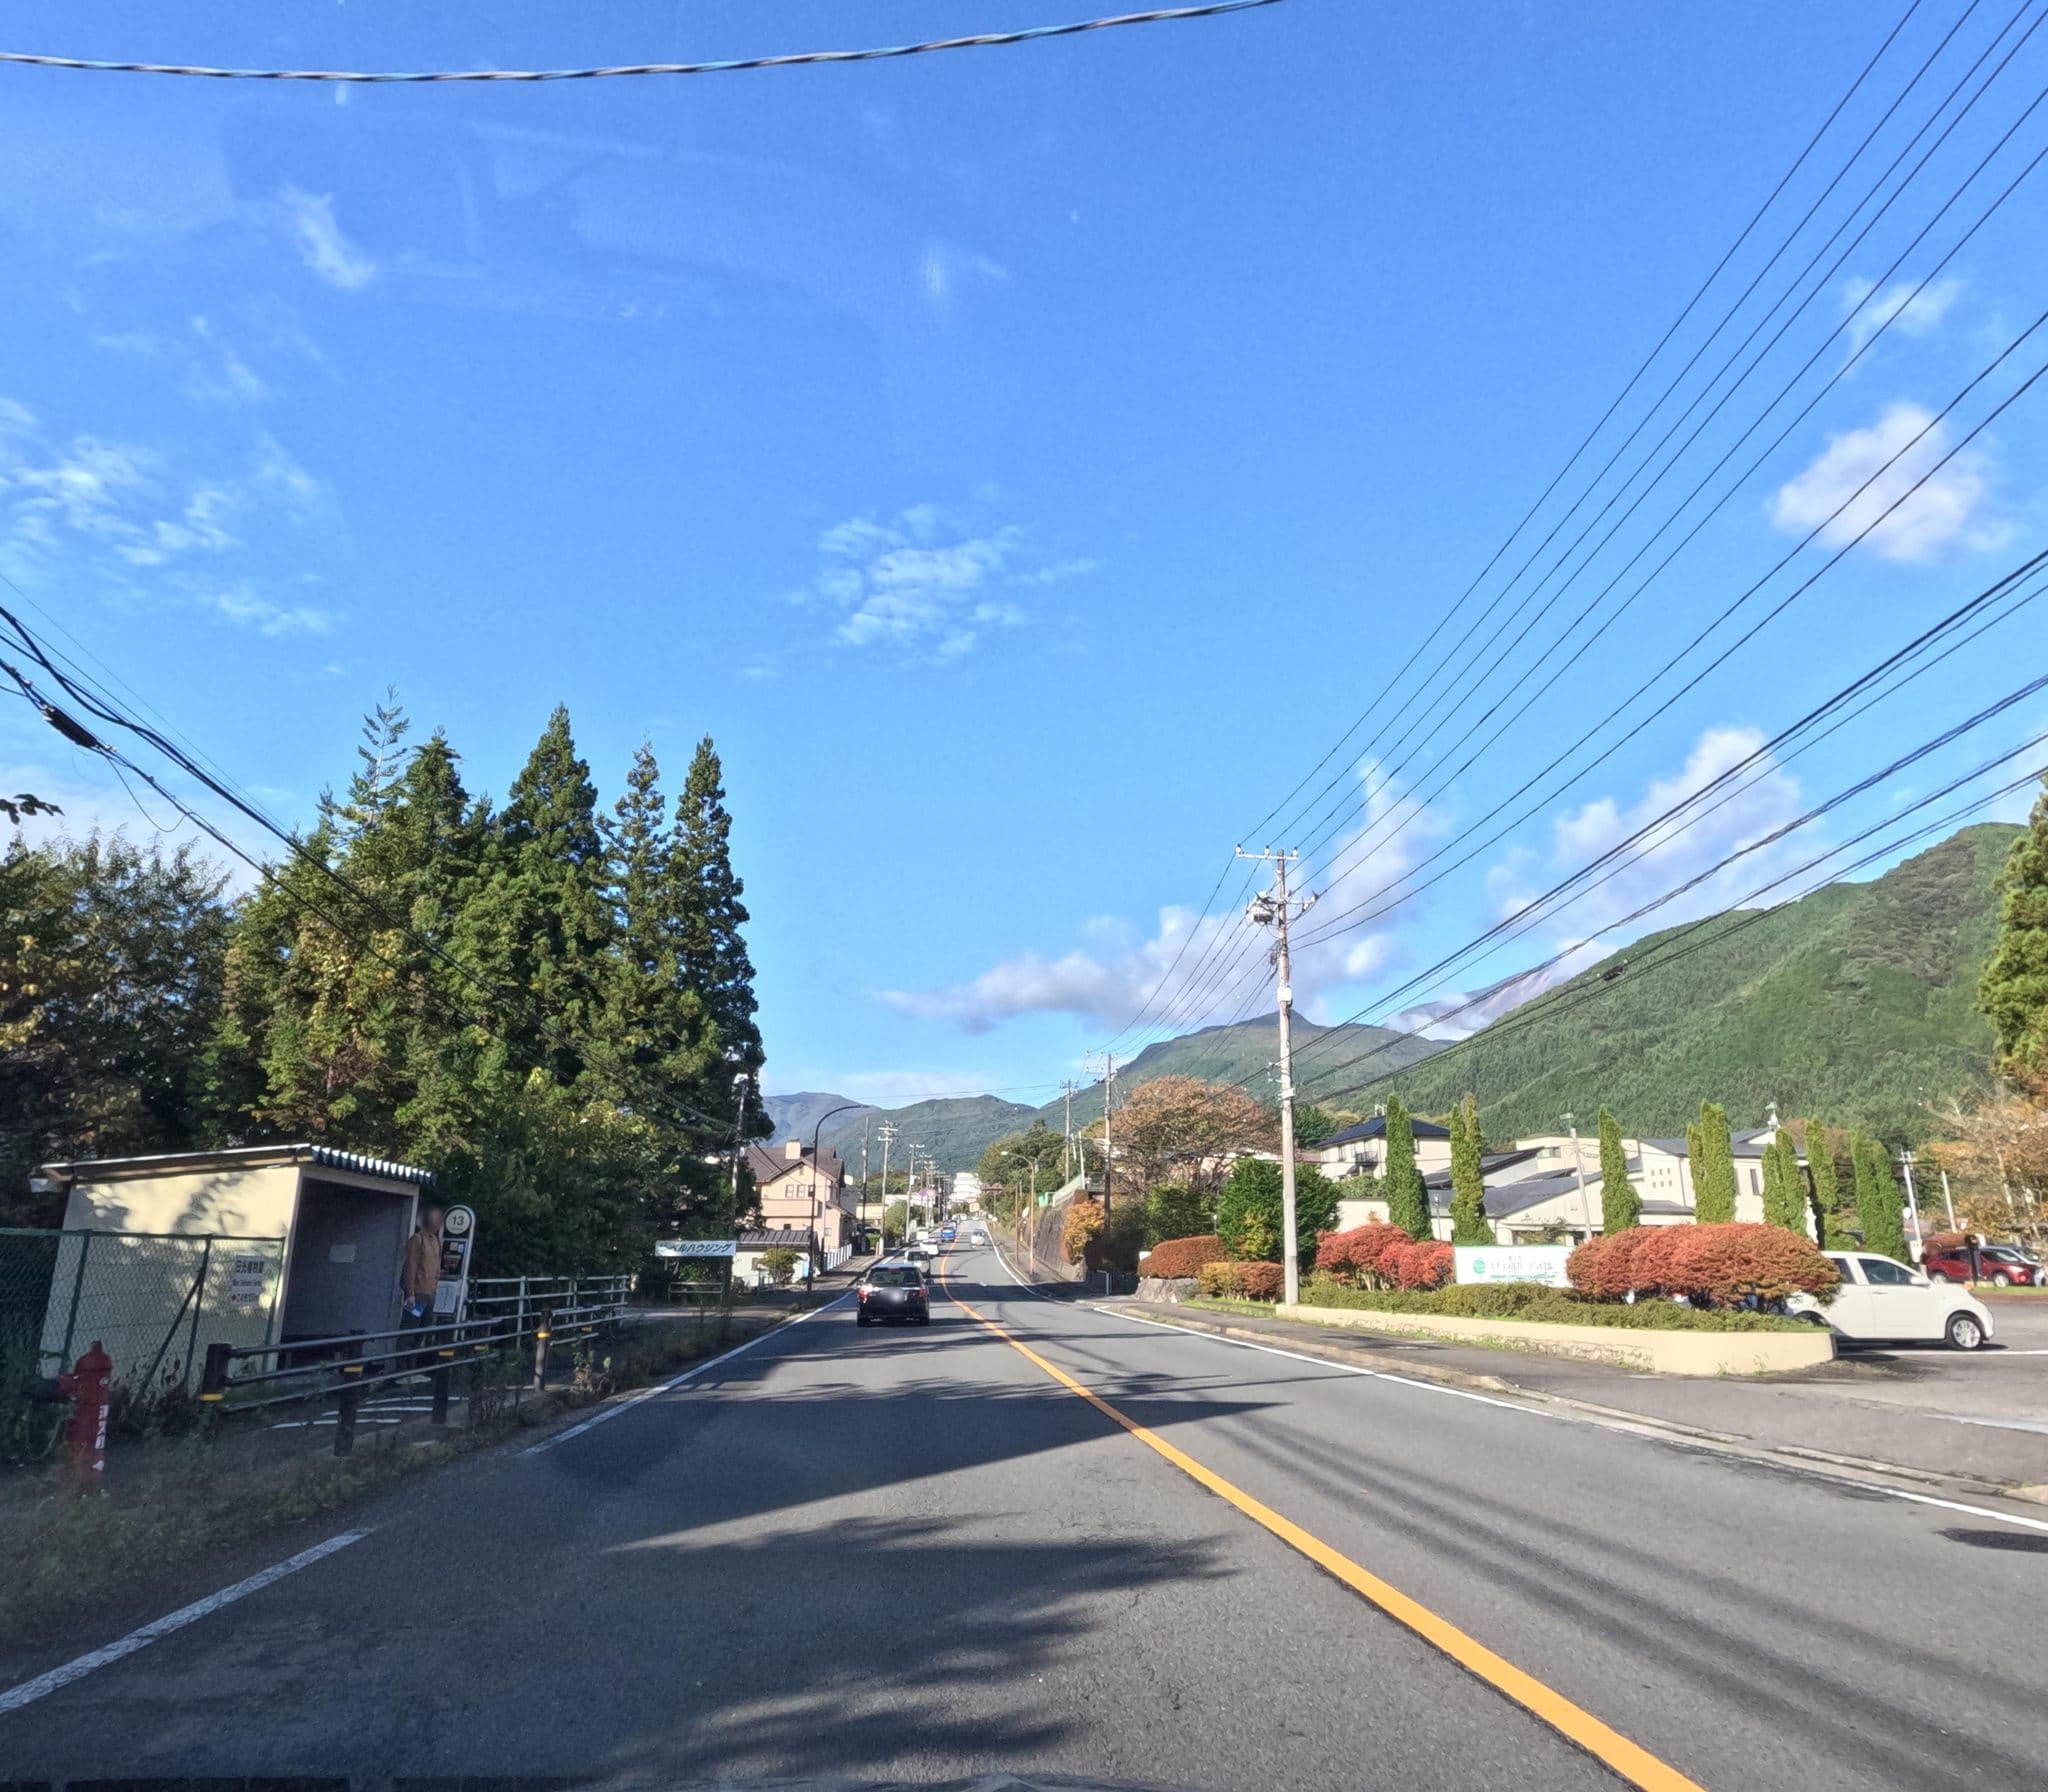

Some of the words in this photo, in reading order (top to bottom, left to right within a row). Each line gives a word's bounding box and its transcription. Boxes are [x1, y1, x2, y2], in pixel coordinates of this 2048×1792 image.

[453, 1215, 464, 1226] 13
[660, 1243, 732, 1253] ベルハウジング
